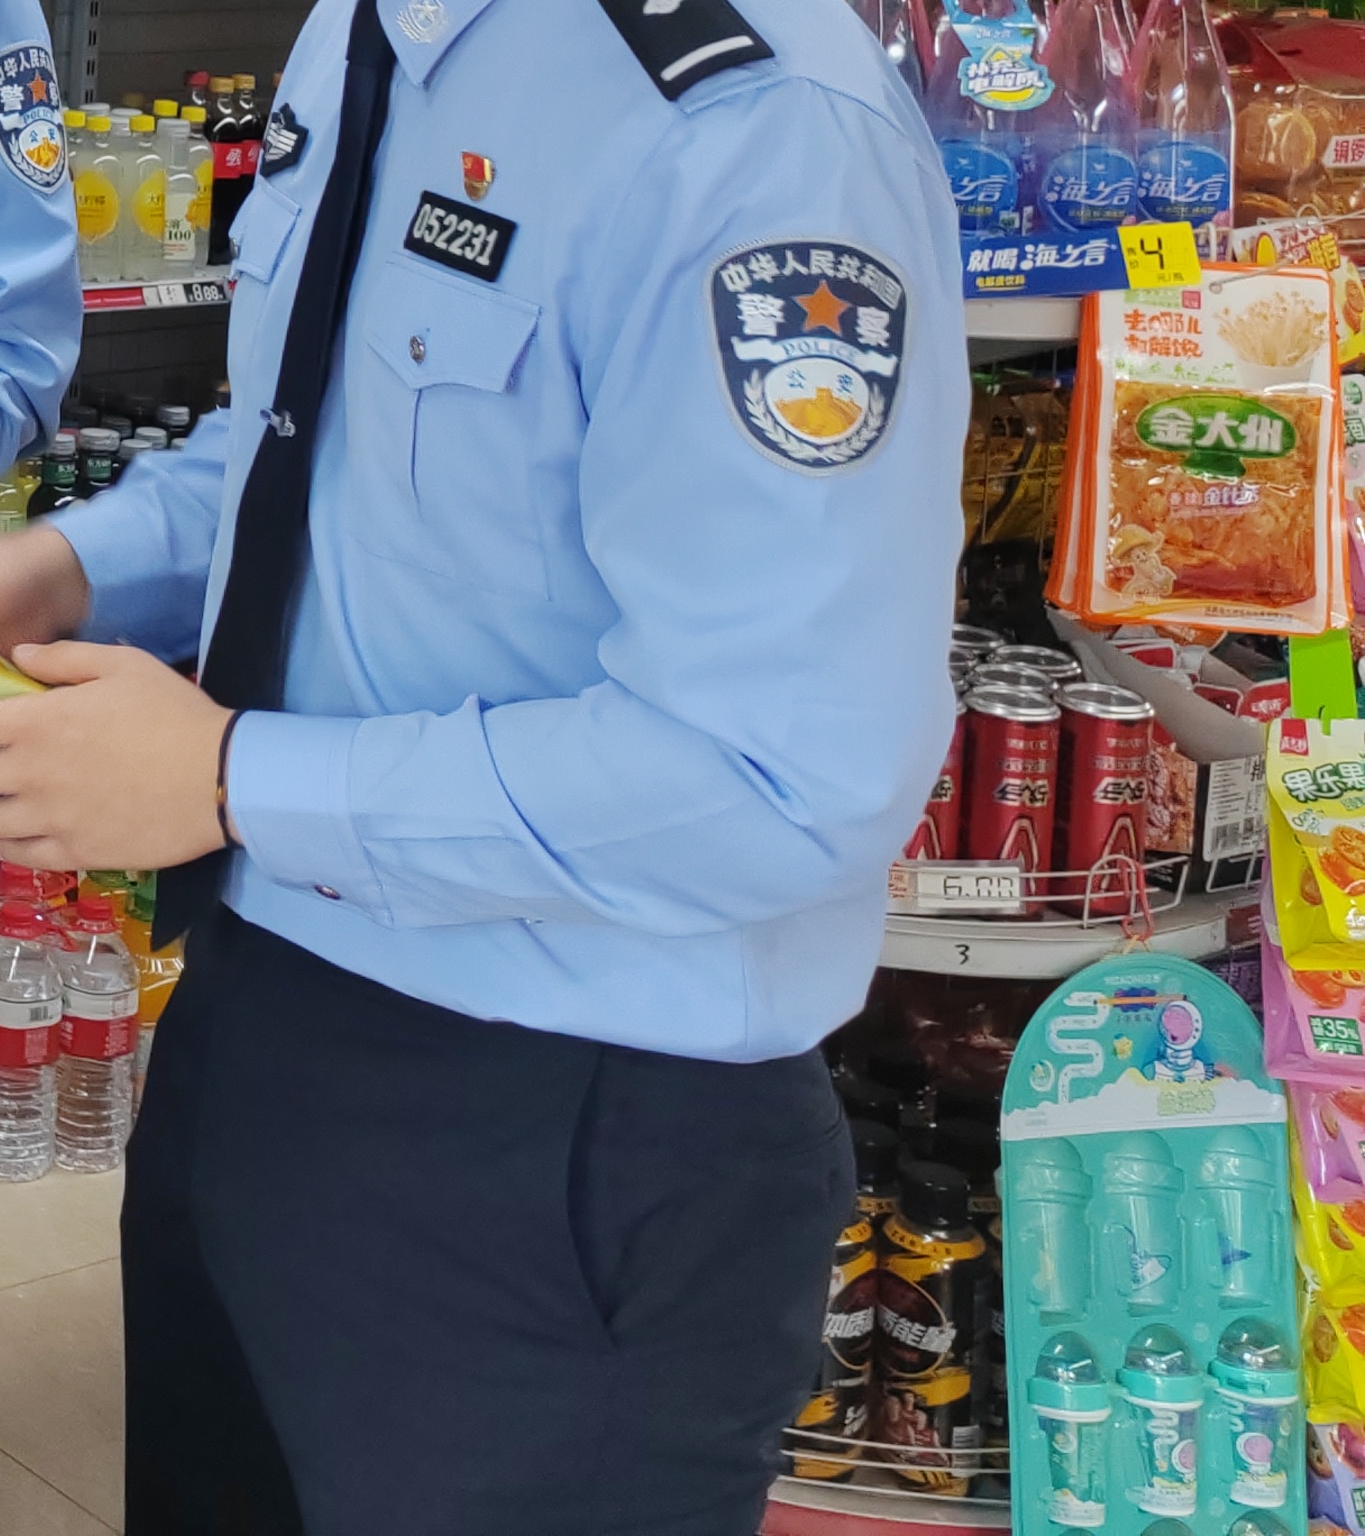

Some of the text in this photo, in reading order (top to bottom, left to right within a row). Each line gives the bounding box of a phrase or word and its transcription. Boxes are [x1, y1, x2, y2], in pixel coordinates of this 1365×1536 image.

[951, 175, 1008, 204] 之言
[1061, 175, 1135, 206] 海之言
[1148, 174, 1226, 205] 海之言
[413, 202, 499, 267] 052231
[1139, 238, 1166, 270] 4
[719, 248, 903, 311] 中华人民共和国
[780, 340, 857, 361] POLICE
[1148, 406, 1284, 455] 金大州
[954, 944, 970, 965] 3
